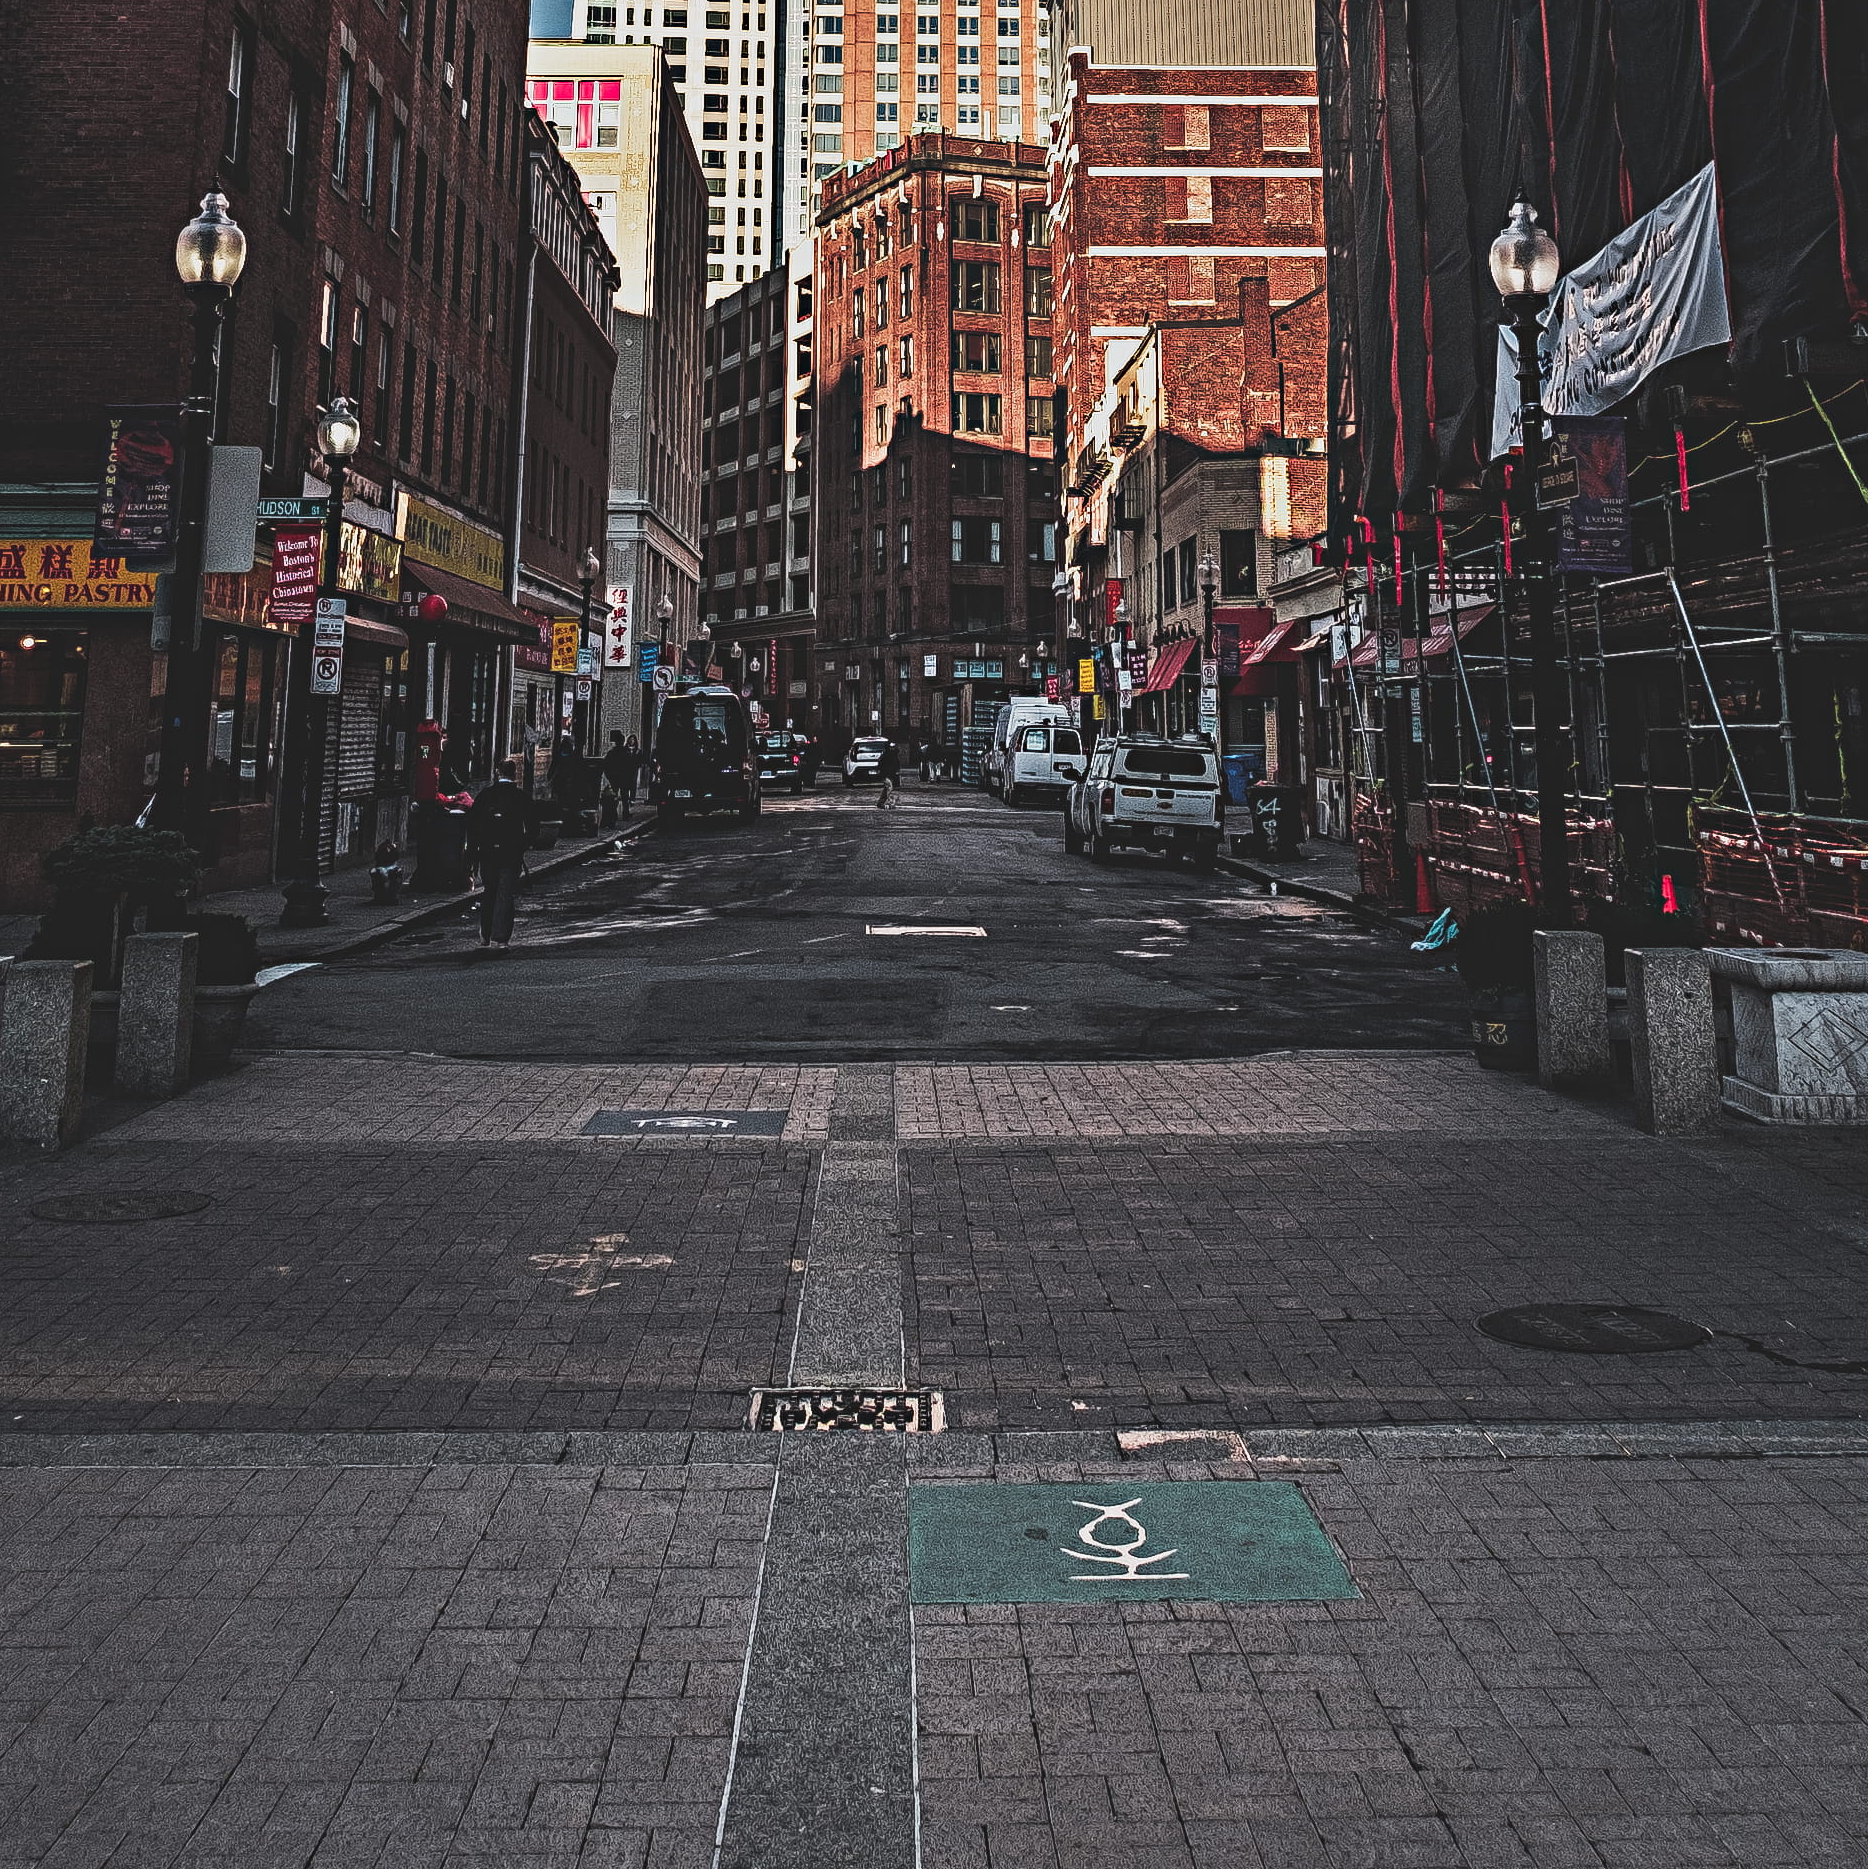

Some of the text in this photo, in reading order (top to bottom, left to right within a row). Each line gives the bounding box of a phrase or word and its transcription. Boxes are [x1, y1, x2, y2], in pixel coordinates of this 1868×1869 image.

[257, 499, 301, 517] HUDSON
[277, 539, 309, 553] Welcome
[275, 566, 315, 584] Historical
[63, 583, 157, 603] PASTRY
[272, 583, 315, 599] Chinatown
